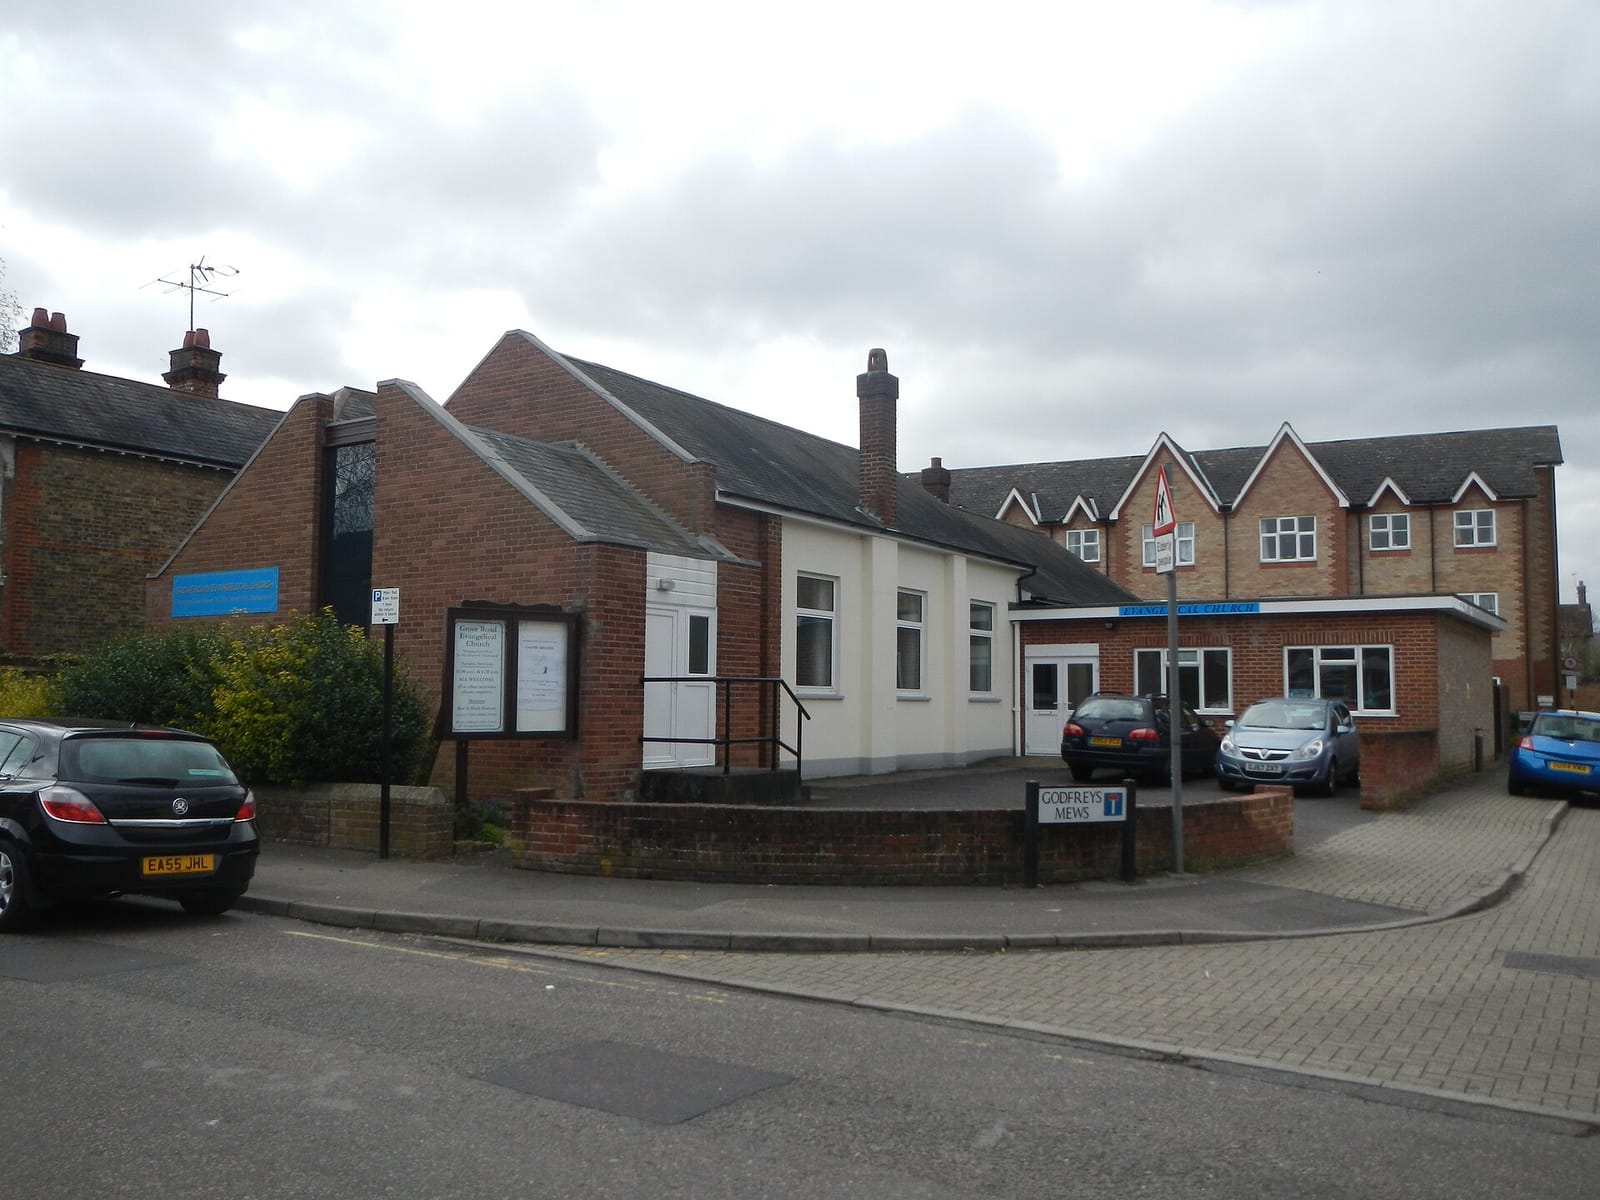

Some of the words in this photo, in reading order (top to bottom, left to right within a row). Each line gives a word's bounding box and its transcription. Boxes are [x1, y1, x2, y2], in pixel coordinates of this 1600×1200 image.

[1124, 605, 1199, 615] EVANGECAL
[1204, 603, 1254, 613] CHURCH
[480, 625, 497, 633] Road
[460, 633, 497, 641] Evangelical
[1042, 791, 1102, 804] GODFREYS
[1055, 807, 1089, 820] MEWS
[148, 858, 182, 872] EA55
[185, 856, 209, 870] JHL
